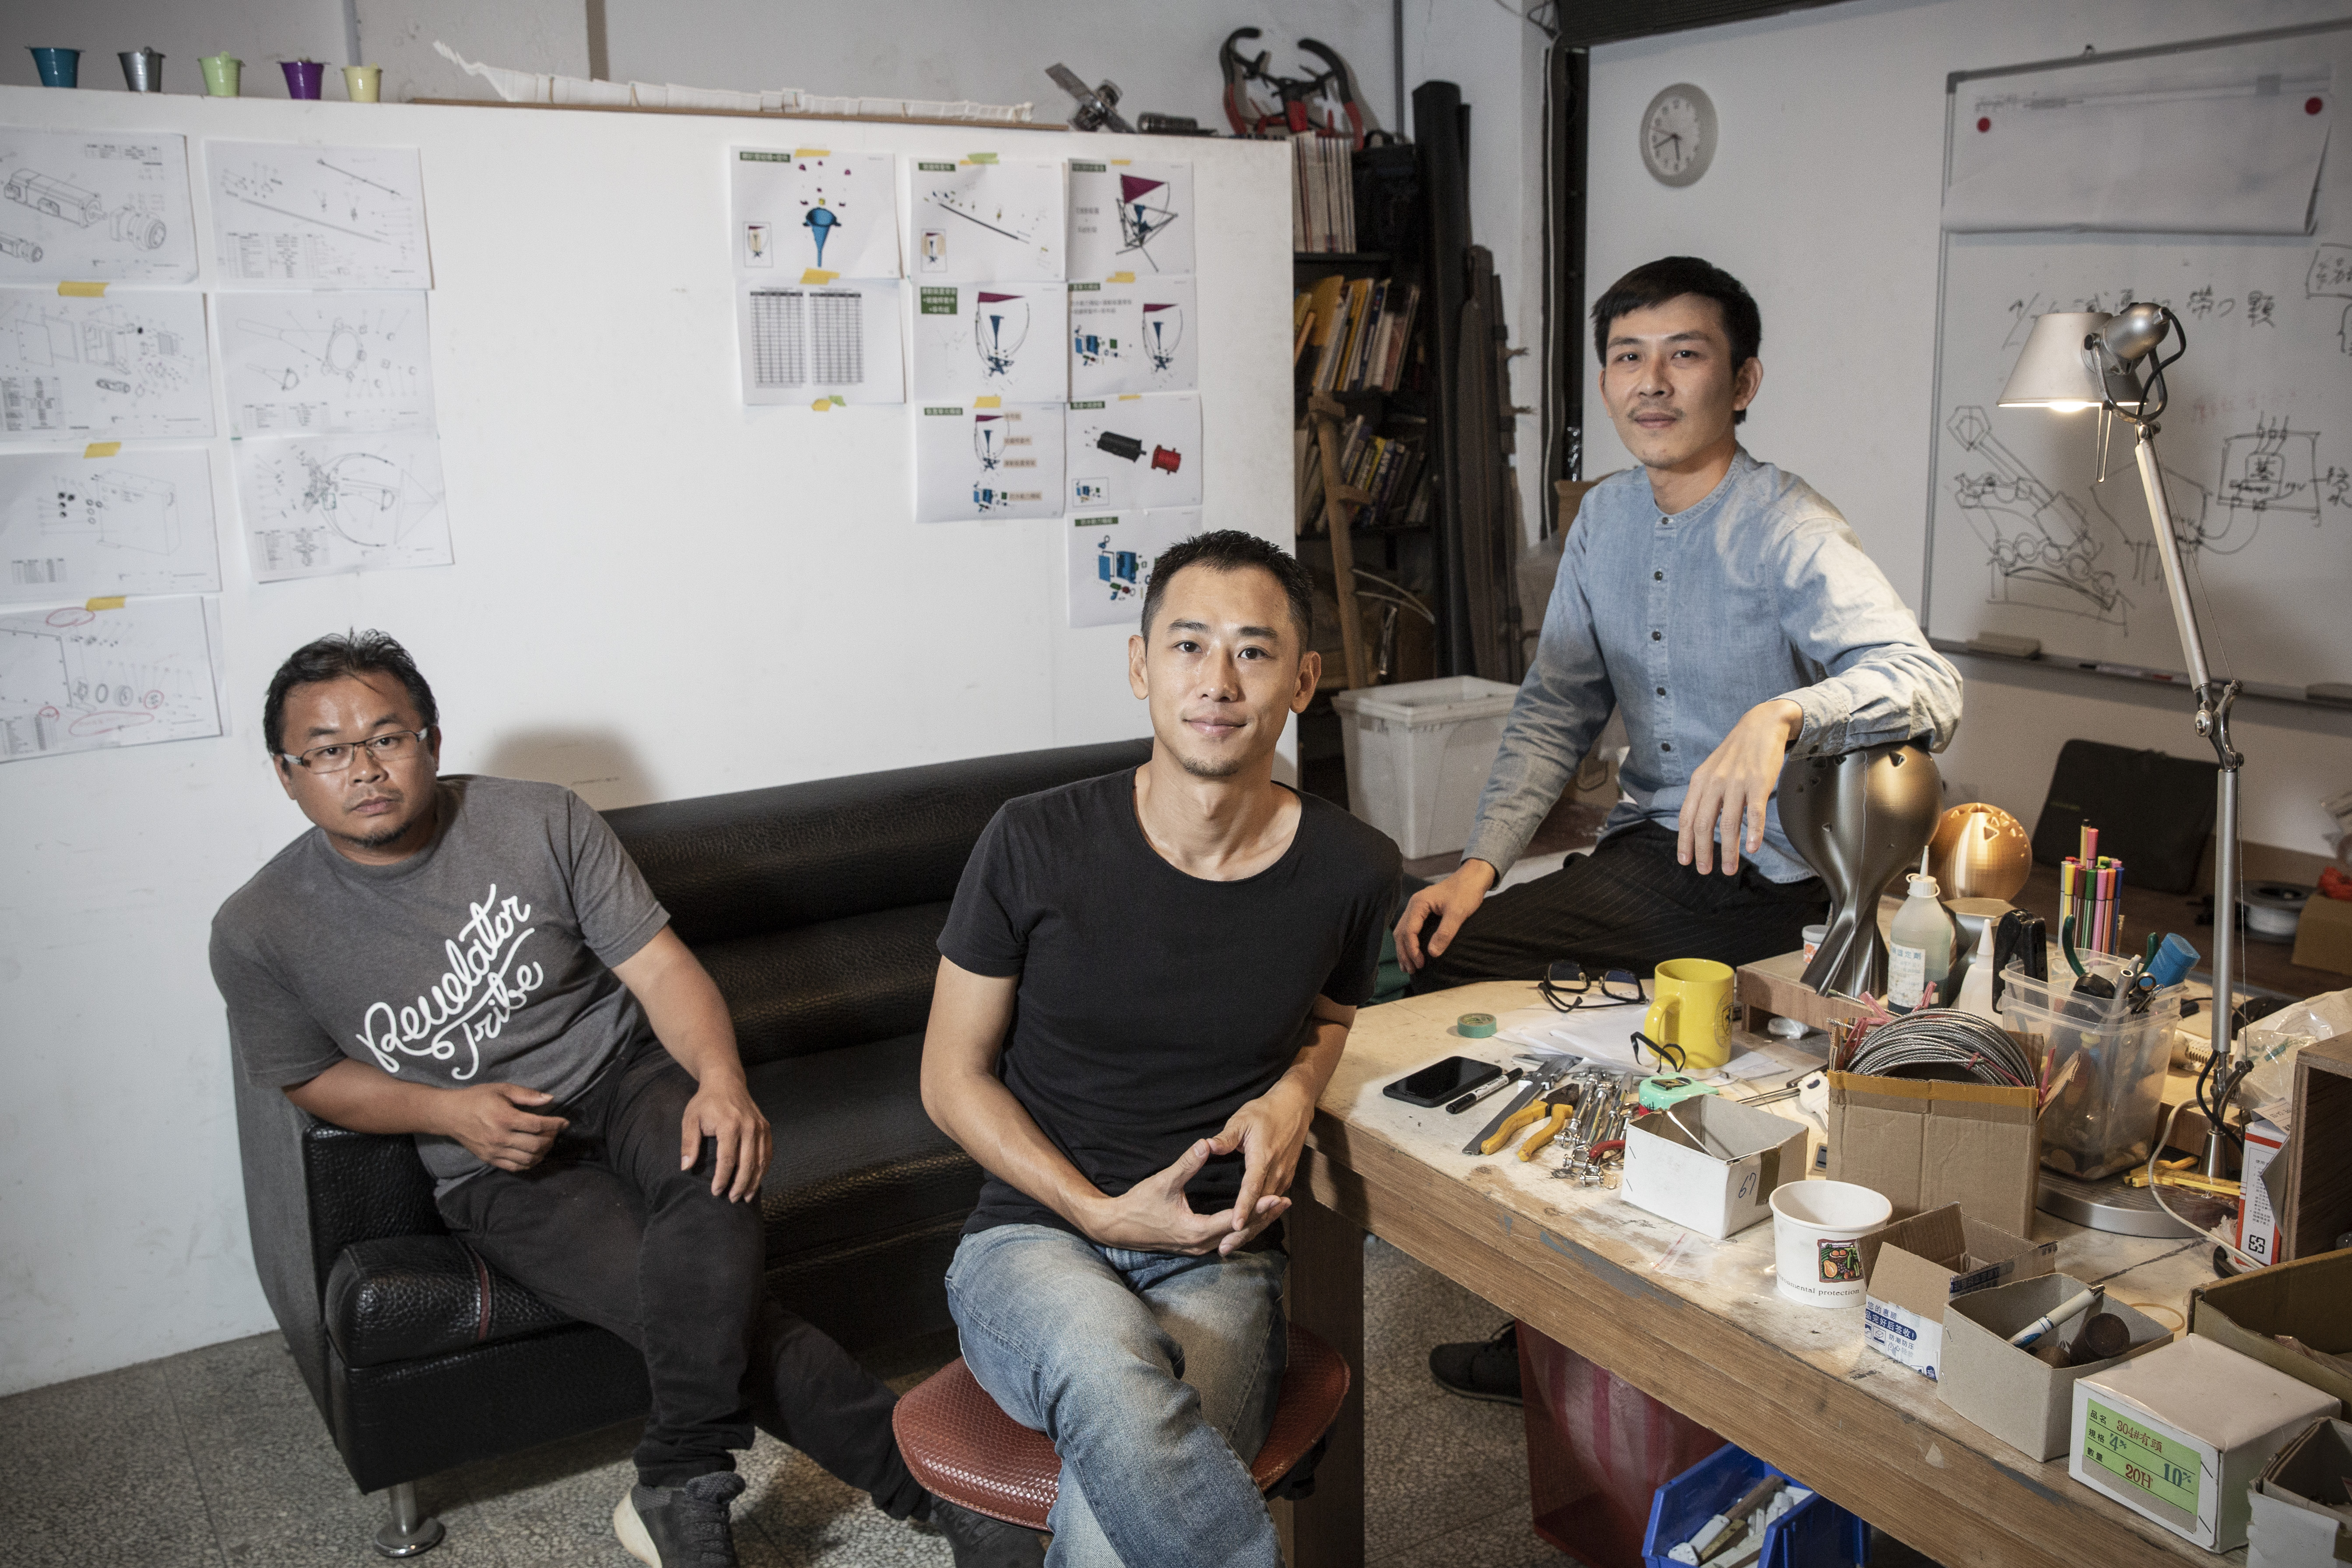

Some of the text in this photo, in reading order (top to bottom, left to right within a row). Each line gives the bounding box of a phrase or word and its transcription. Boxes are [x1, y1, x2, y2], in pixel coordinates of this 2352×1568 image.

[1738, 1172, 1756, 1198] 67
[1867, 1301, 1897, 1321] 您的惠顾
[1889, 1333, 1914, 1350] 防潮防压
[2088, 1428, 2105, 1444] 規格
[2090, 1410, 2162, 1453] 品名 304#有頭
[2087, 1446, 2103, 1463] 數量
